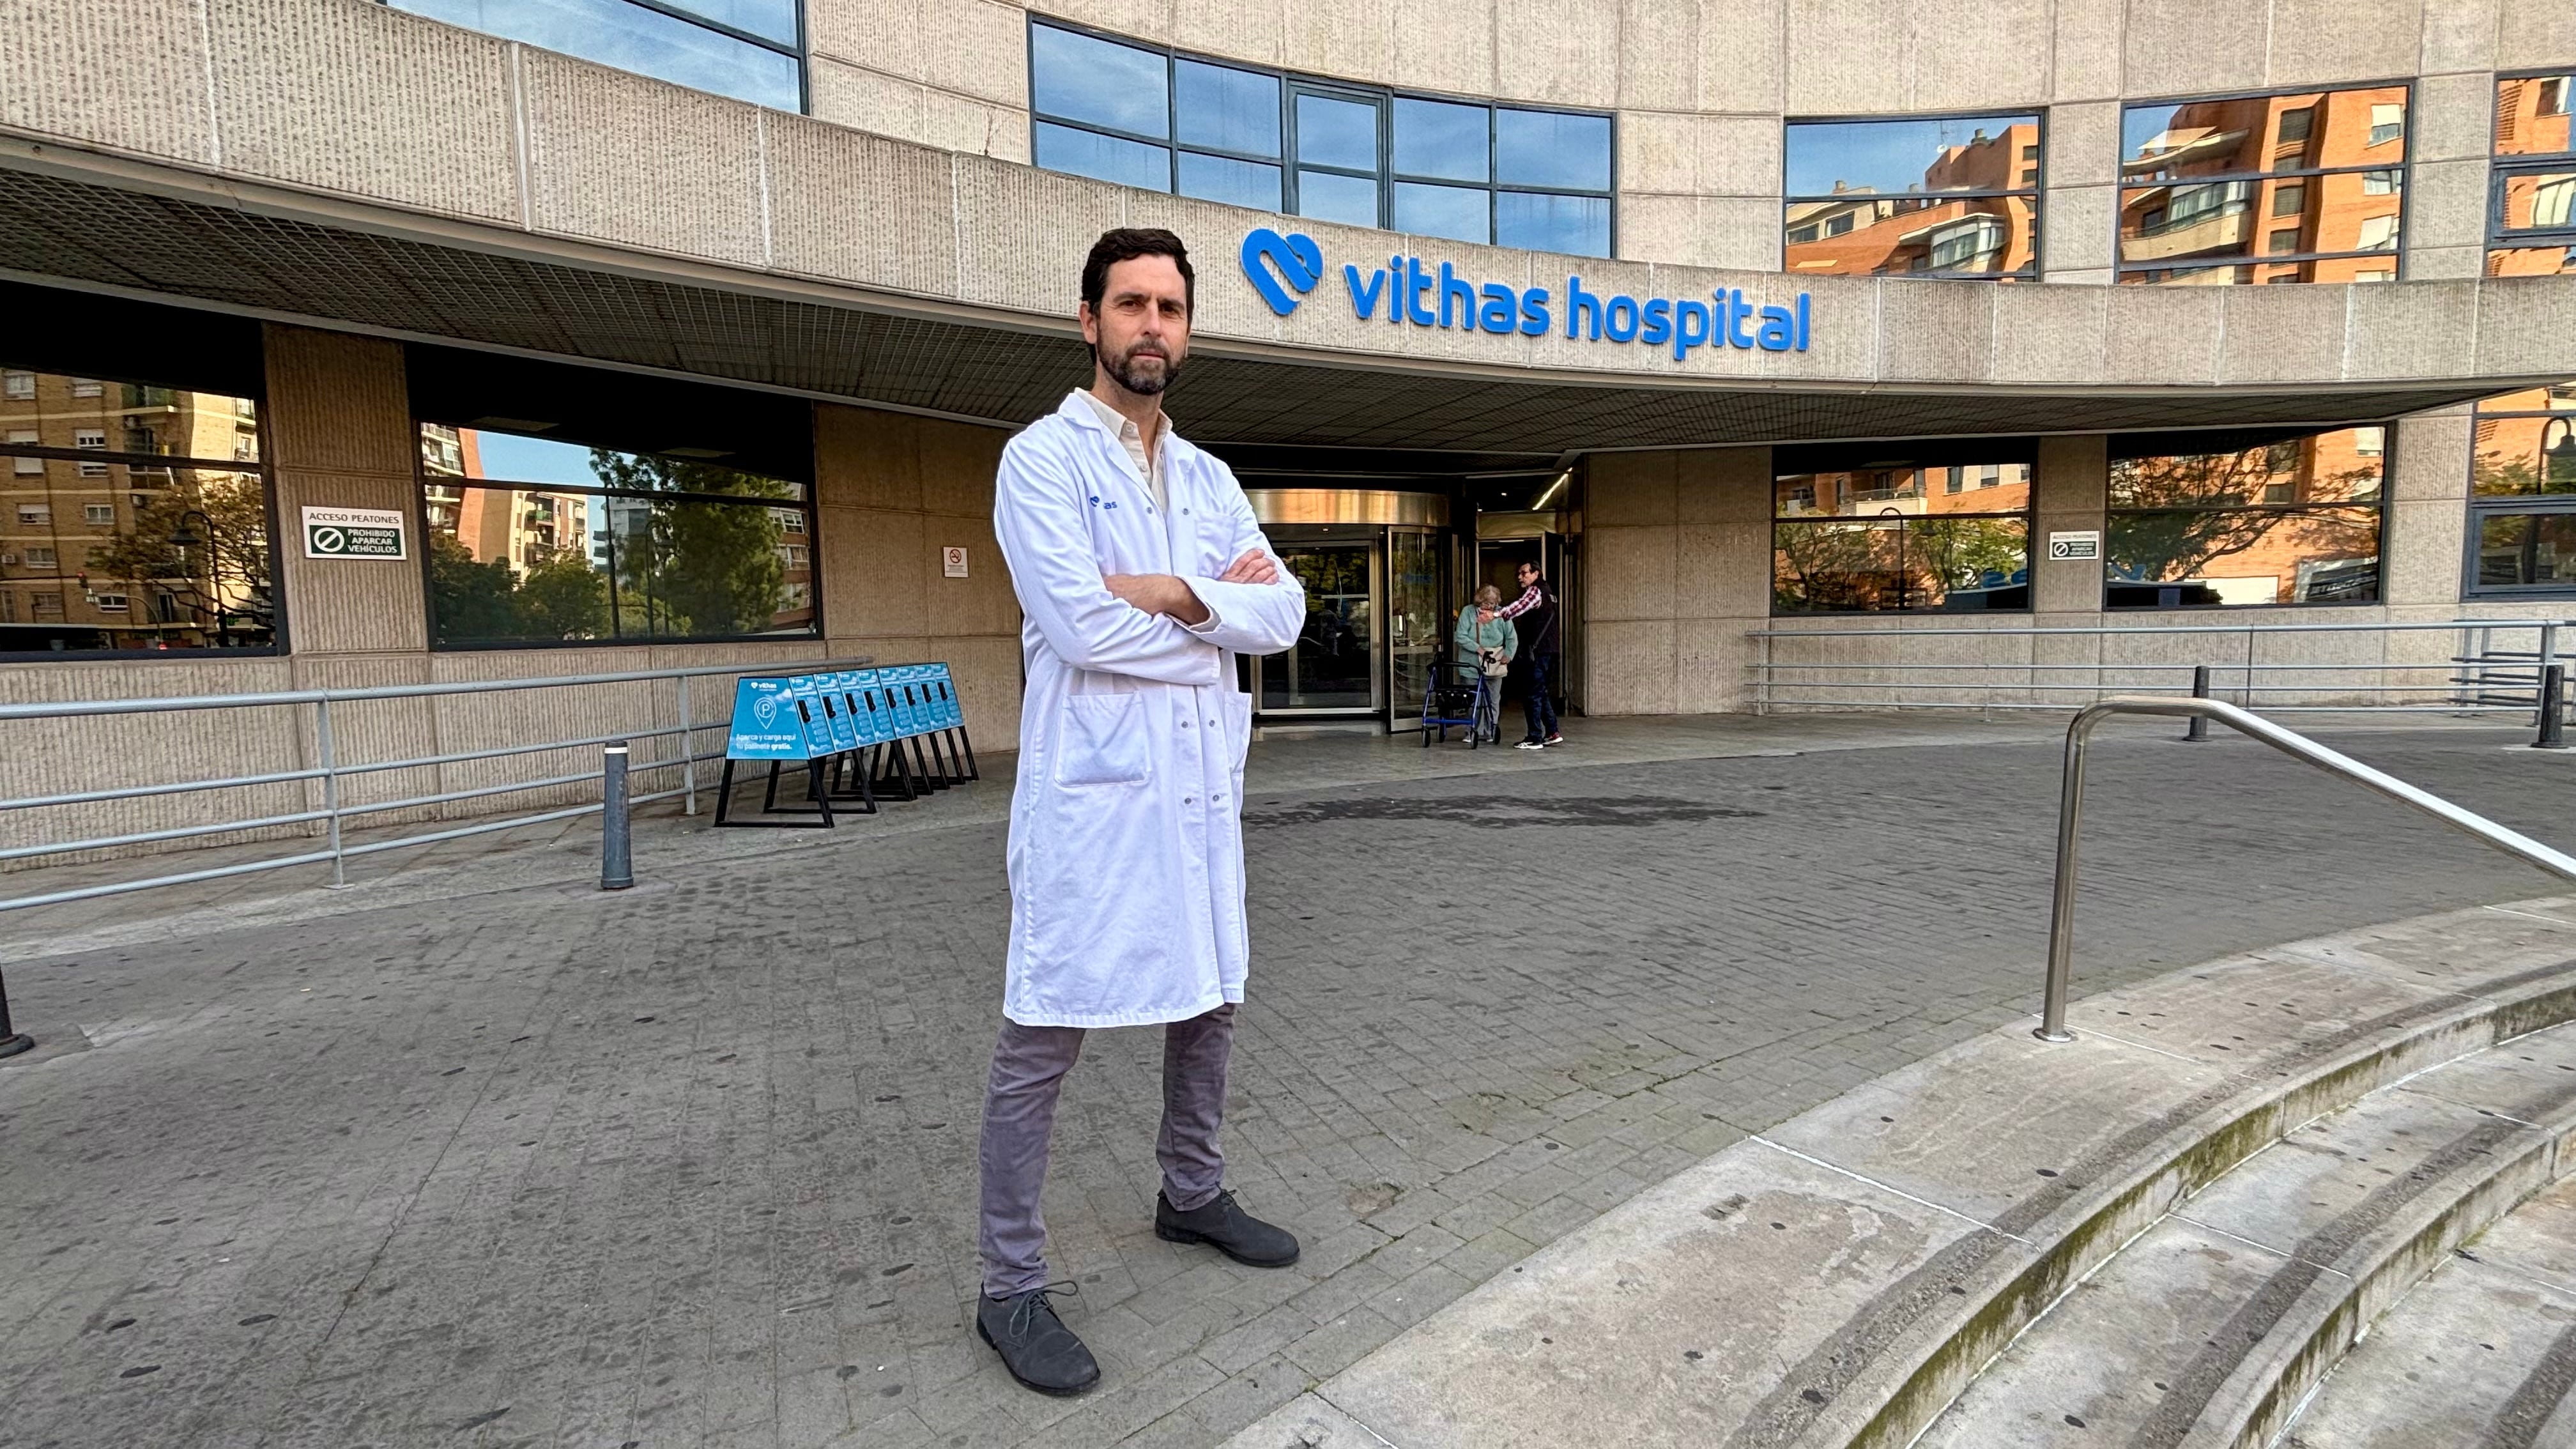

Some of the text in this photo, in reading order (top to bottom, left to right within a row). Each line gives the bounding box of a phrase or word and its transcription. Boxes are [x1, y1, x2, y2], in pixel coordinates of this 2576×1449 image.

[1344, 255, 1811, 360] vithas hospital
[309, 512, 399, 524] ACCESO PEATONES
[348, 529, 395, 538] PROHIBIDO
[351, 537, 392, 546] APARCAR
[348, 544, 397, 553] VEHÍCULOS
